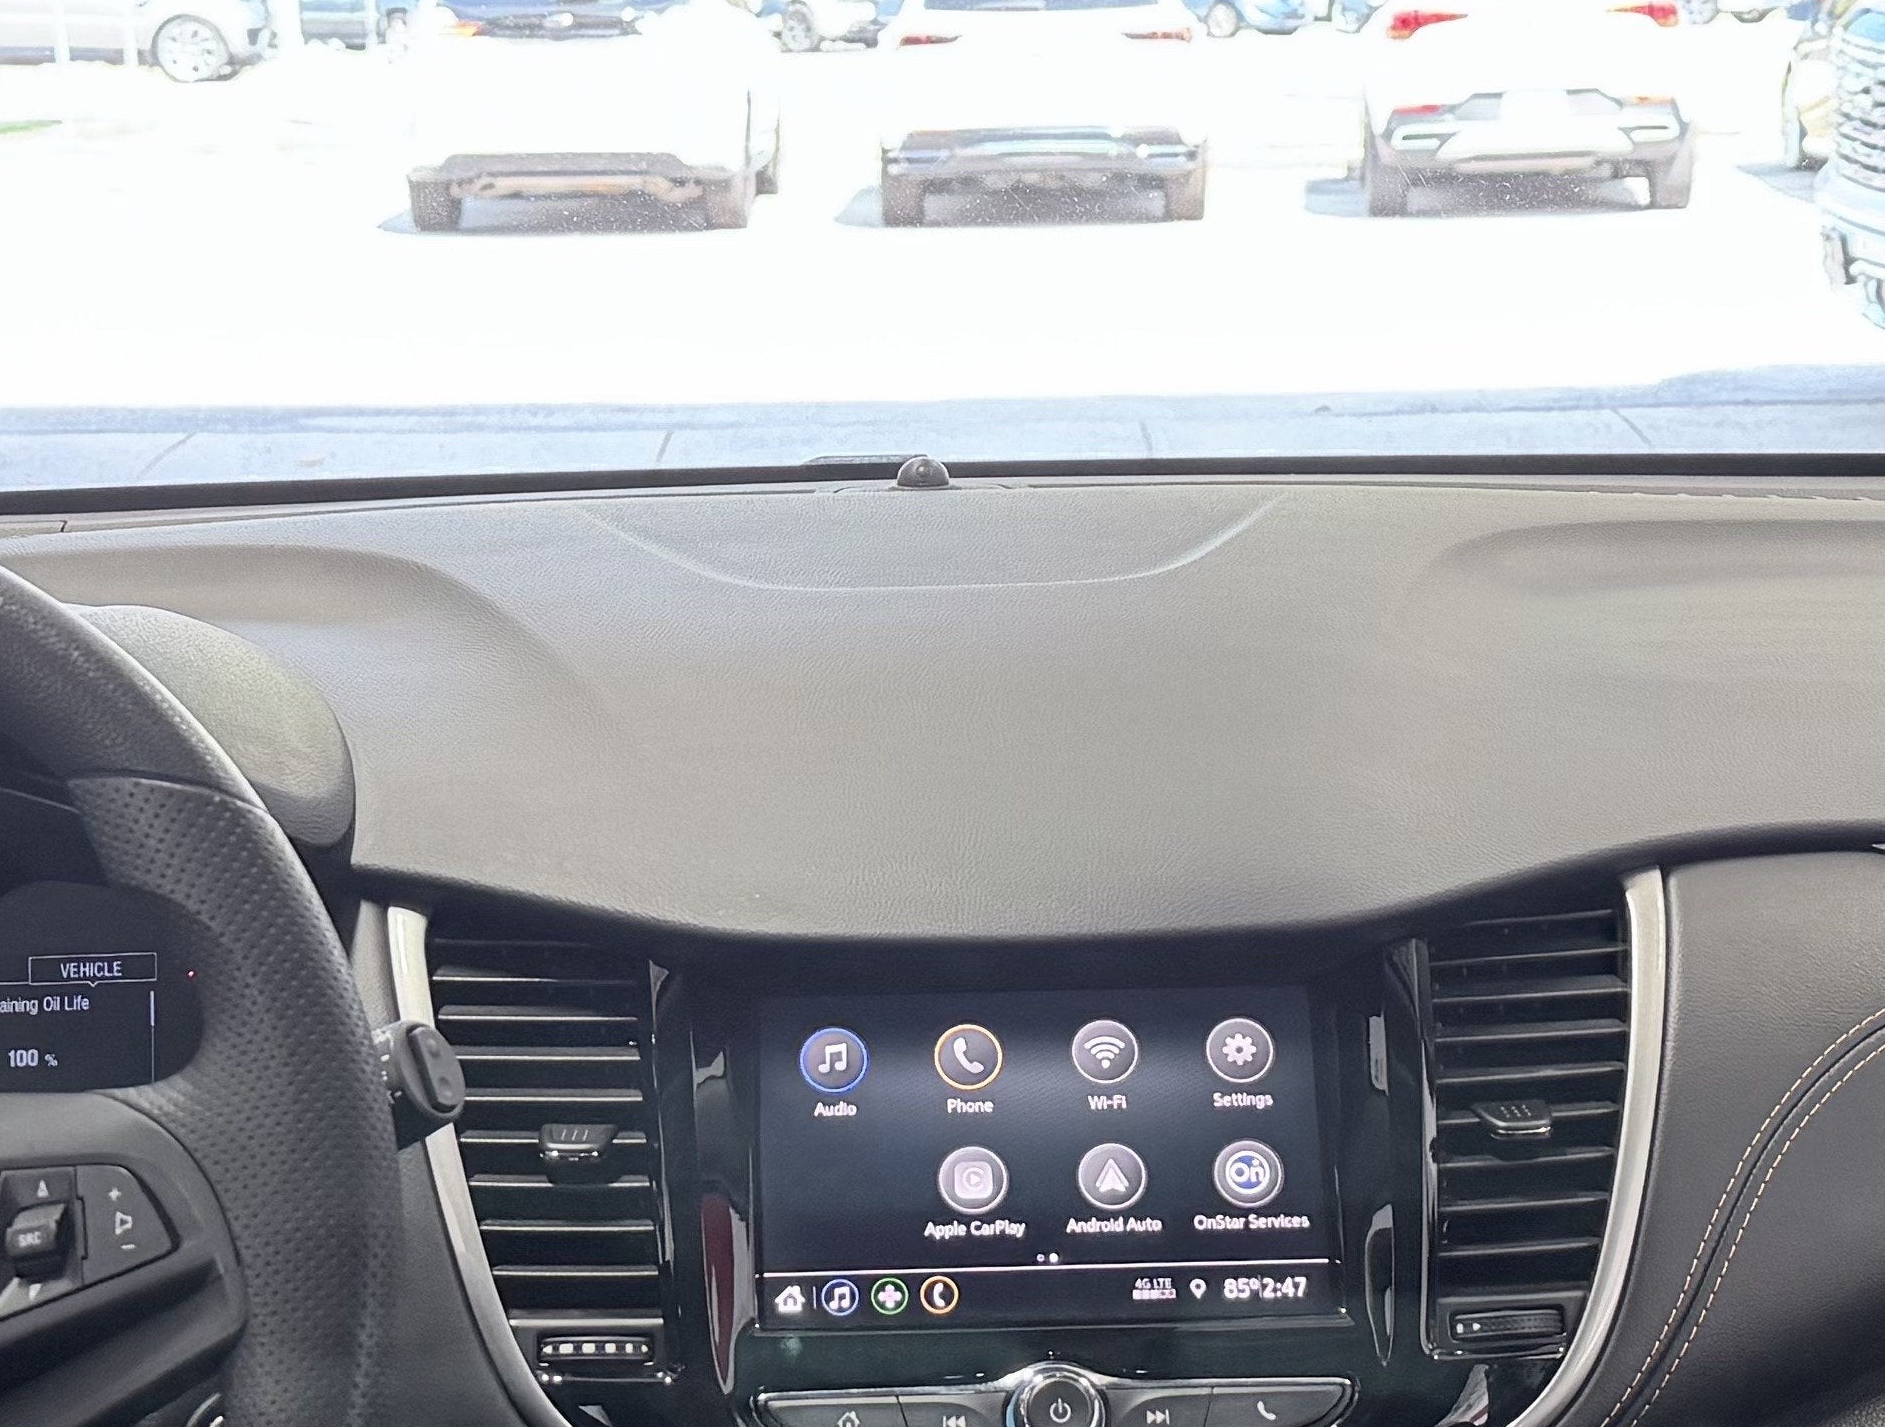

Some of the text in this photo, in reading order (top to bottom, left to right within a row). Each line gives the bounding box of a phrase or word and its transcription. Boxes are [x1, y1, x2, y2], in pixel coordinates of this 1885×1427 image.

[60, 961, 122, 978] VEHICLE
[43, 996, 60, 1012] Oil
[64, 995, 89, 1011] Life
[8, 1049, 58, 1068] 100 %
[814, 1101, 857, 1117] Audio
[947, 1099, 994, 1114] Phone
[1088, 1095, 1127, 1110] Wi-Fi
[1213, 1093, 1274, 1110] Settings
[924, 1220, 1026, 1240] Apple CarPlay
[1066, 1216, 1162, 1233] Android Auto
[1193, 1214, 1310, 1230] OnStar Services
[19, 1231, 42, 1247] SRC
[1135, 1278, 1172, 1289] 4G LTE
